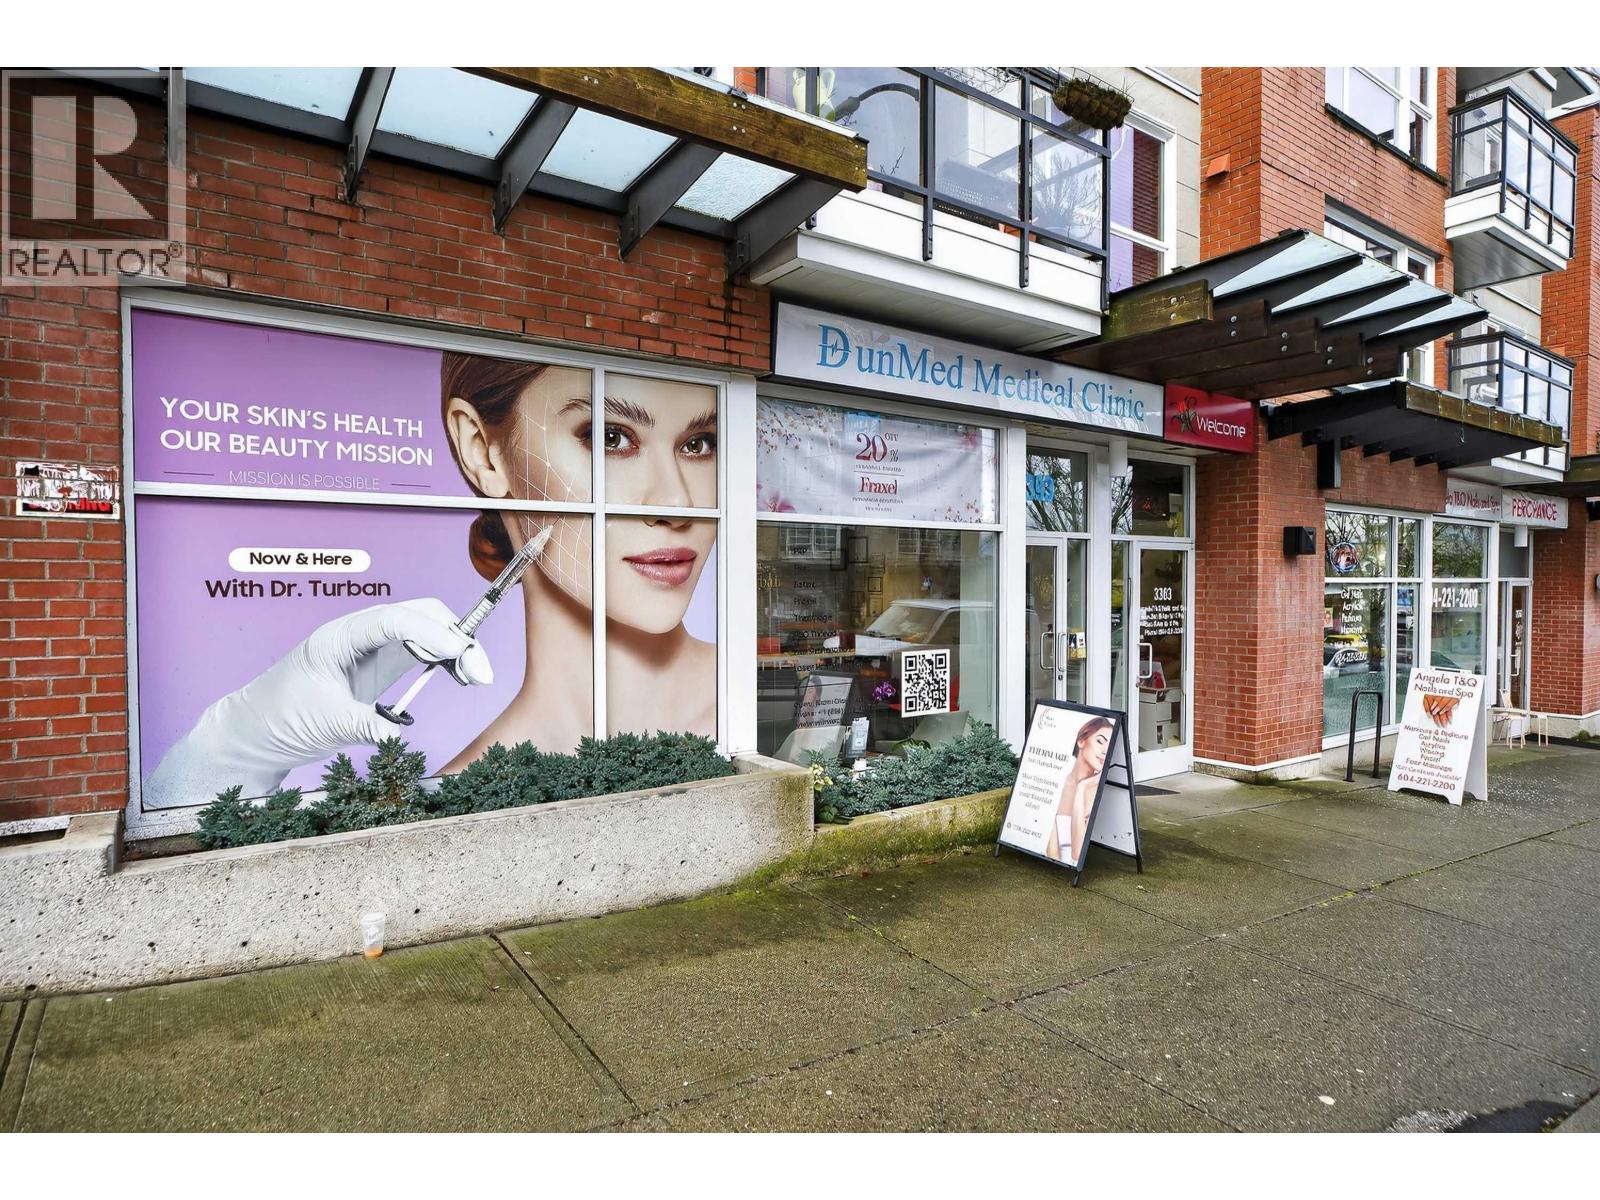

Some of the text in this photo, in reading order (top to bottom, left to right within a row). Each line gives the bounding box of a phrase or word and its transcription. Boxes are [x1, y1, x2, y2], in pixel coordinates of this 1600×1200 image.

[816, 324, 1144, 422] DunMed Medical Clinic
[160, 397, 423, 438] YOUR SKIN'S HEALTH
[1196, 416, 1246, 438] Welcome
[160, 429, 433, 466] OUR BEAUTY MISSION
[856, 432, 887, 462] 20
[229, 470, 380, 490] MISSION IS POSSIBLE
[859, 476, 898, 495] Fraxel
[249, 552, 352, 567] Now & Here
[205, 579, 391, 598] With Dr. Turban
[1415, 672, 1450, 686] Angela
[1414, 683, 1474, 699] Nails and Spa
[1397, 773, 1456, 791] 604-221-2200
